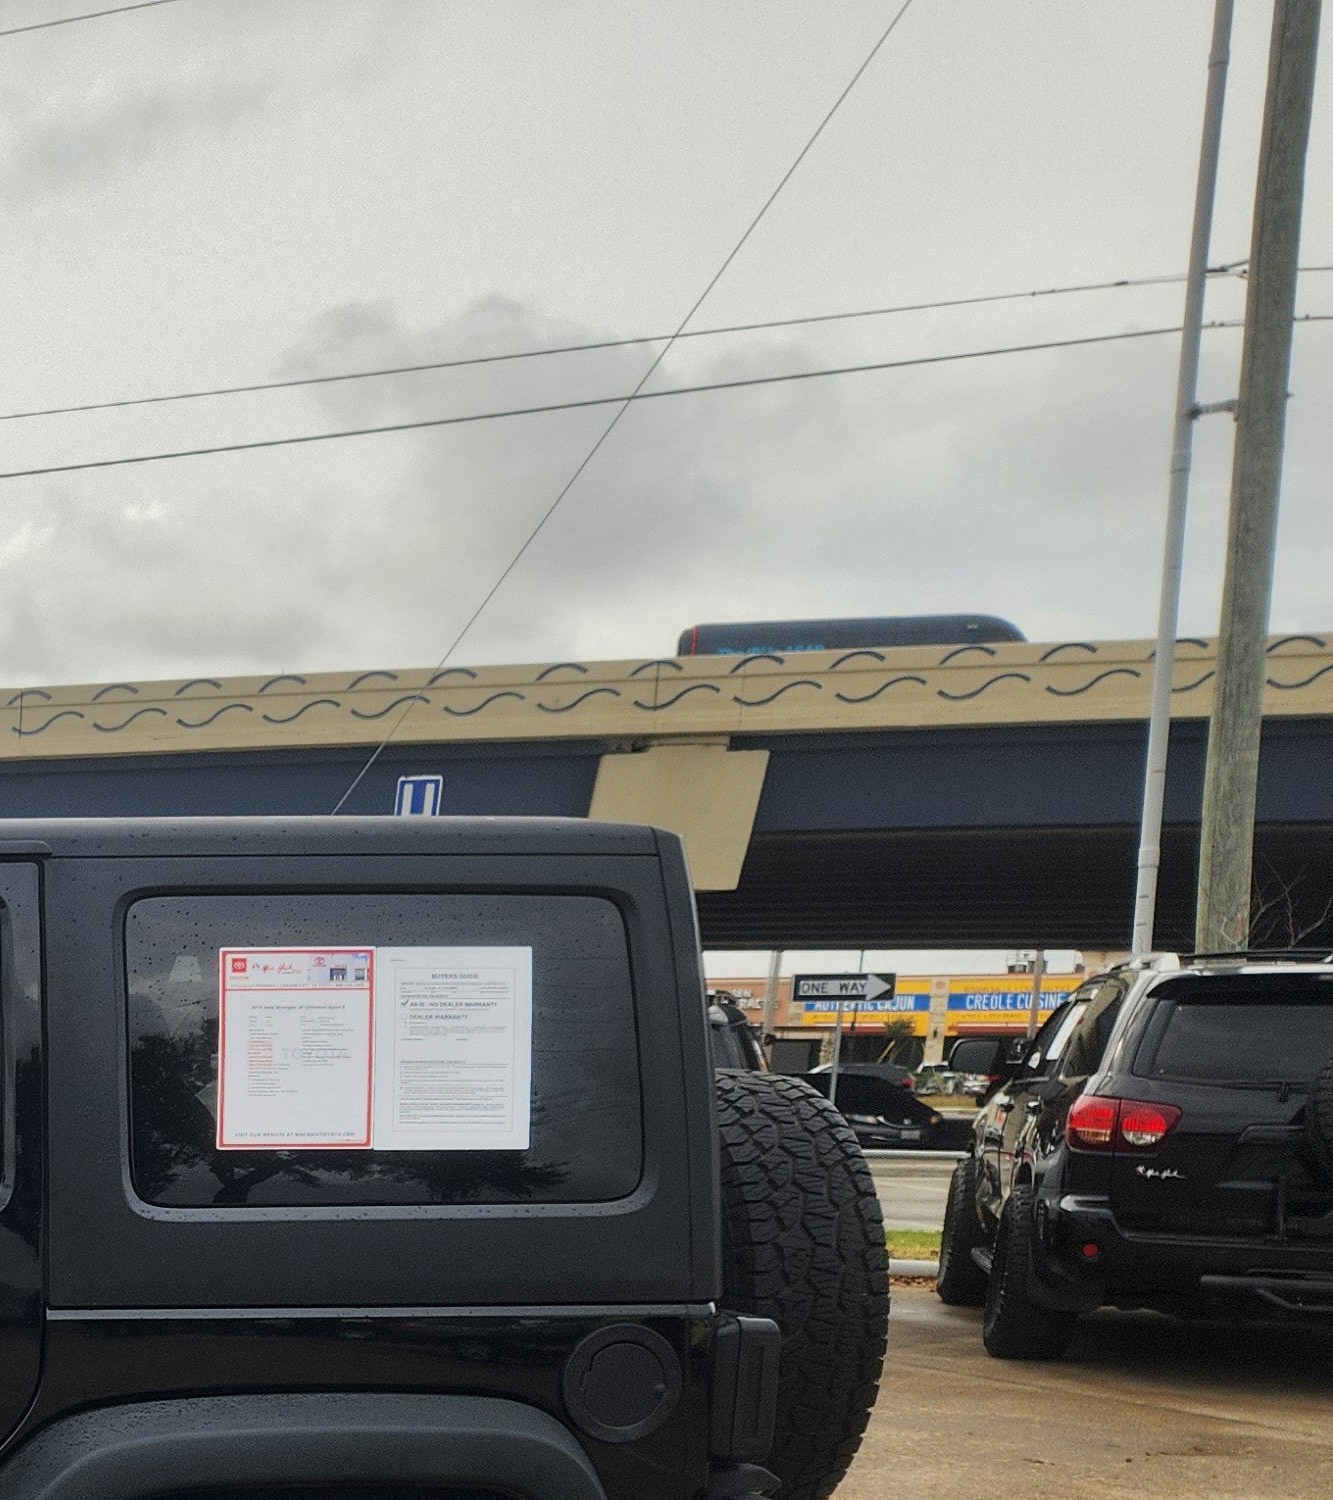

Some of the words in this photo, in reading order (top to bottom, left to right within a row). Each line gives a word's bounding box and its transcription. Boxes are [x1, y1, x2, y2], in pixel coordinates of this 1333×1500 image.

[801, 982, 829, 995] ONE
[839, 981, 867, 994] WAY
[965, 992, 1015, 1010] CREOLE
[1016, 992, 1066, 1010] CUSINE
